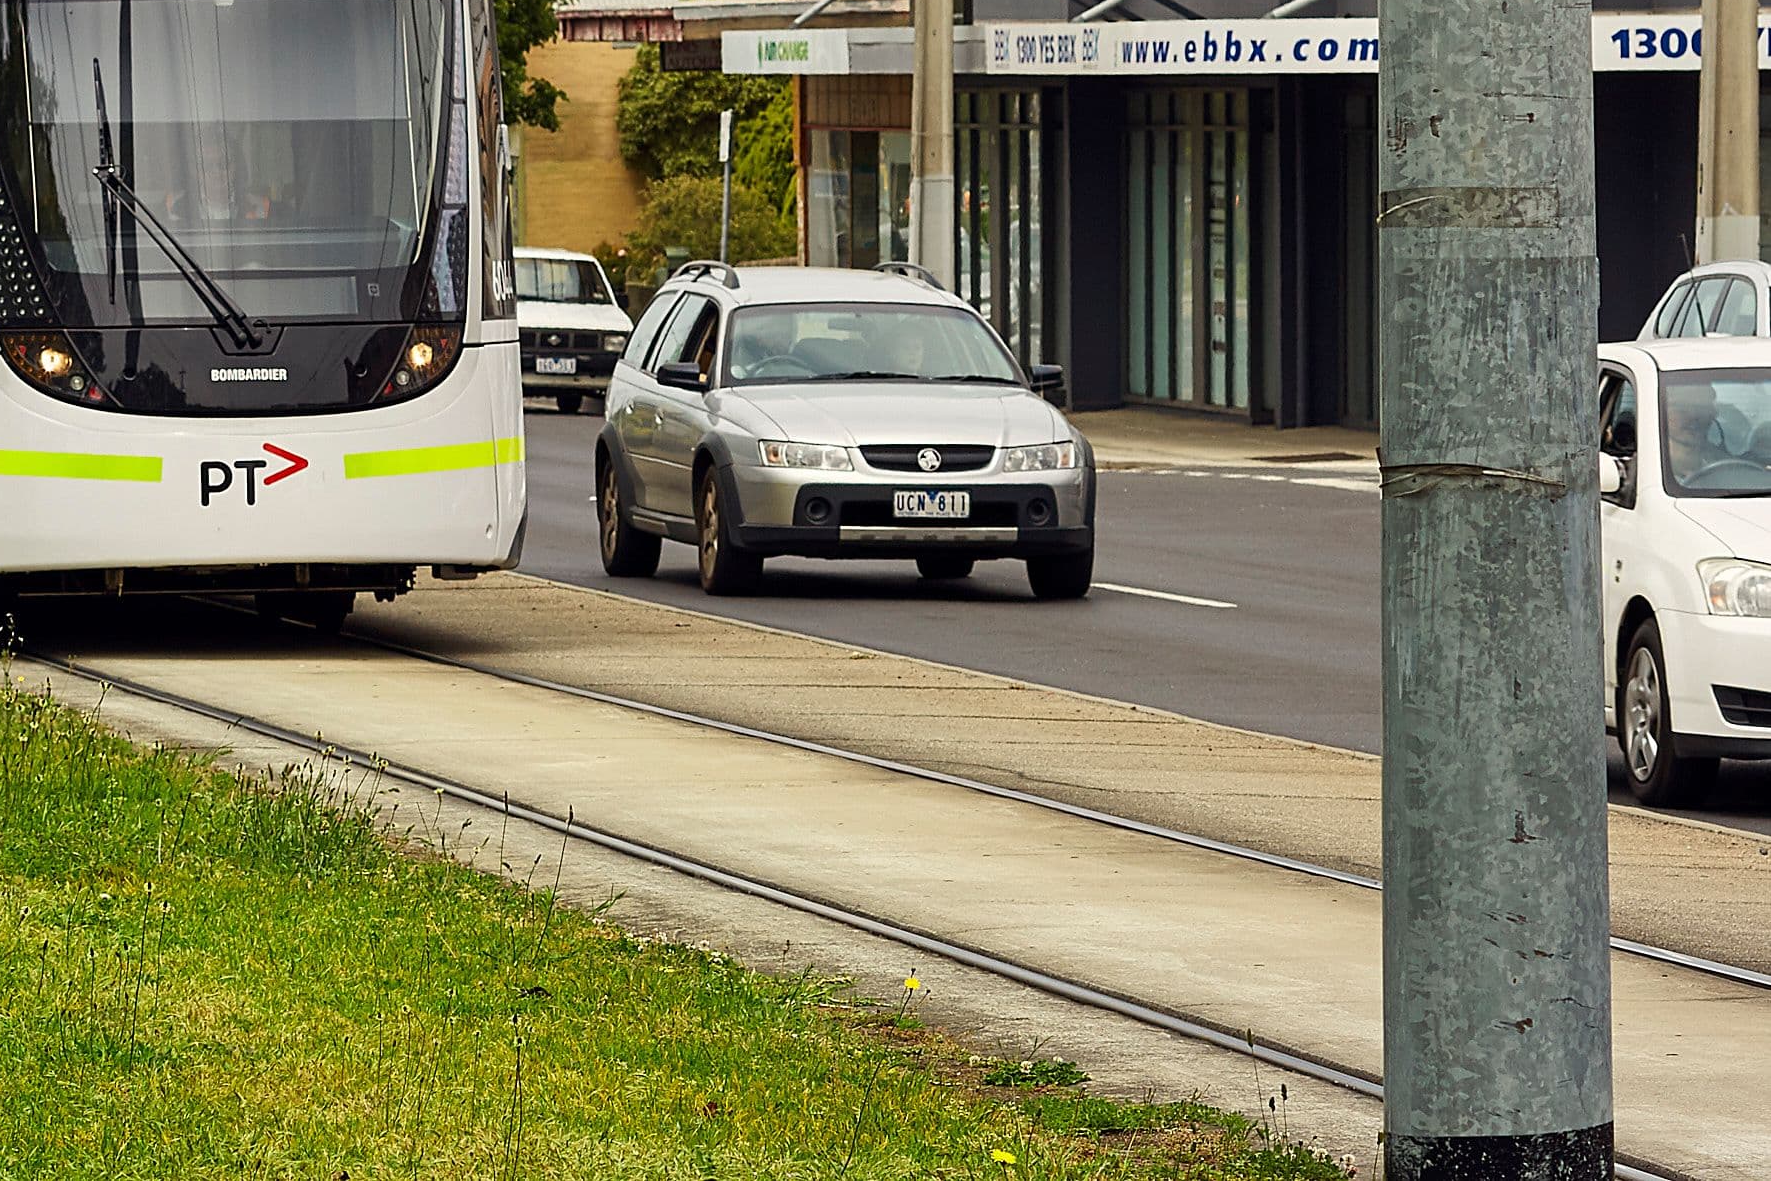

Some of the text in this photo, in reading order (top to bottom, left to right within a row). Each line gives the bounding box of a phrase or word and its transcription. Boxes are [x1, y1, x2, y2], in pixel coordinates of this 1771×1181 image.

[1016, 35, 1077, 63] 1300 YES BBX
[1122, 30, 1379, 63] www.ebbx.com
[210, 368, 288, 382] BOMBARDIER
[896, 494, 966, 511] UCN 811
